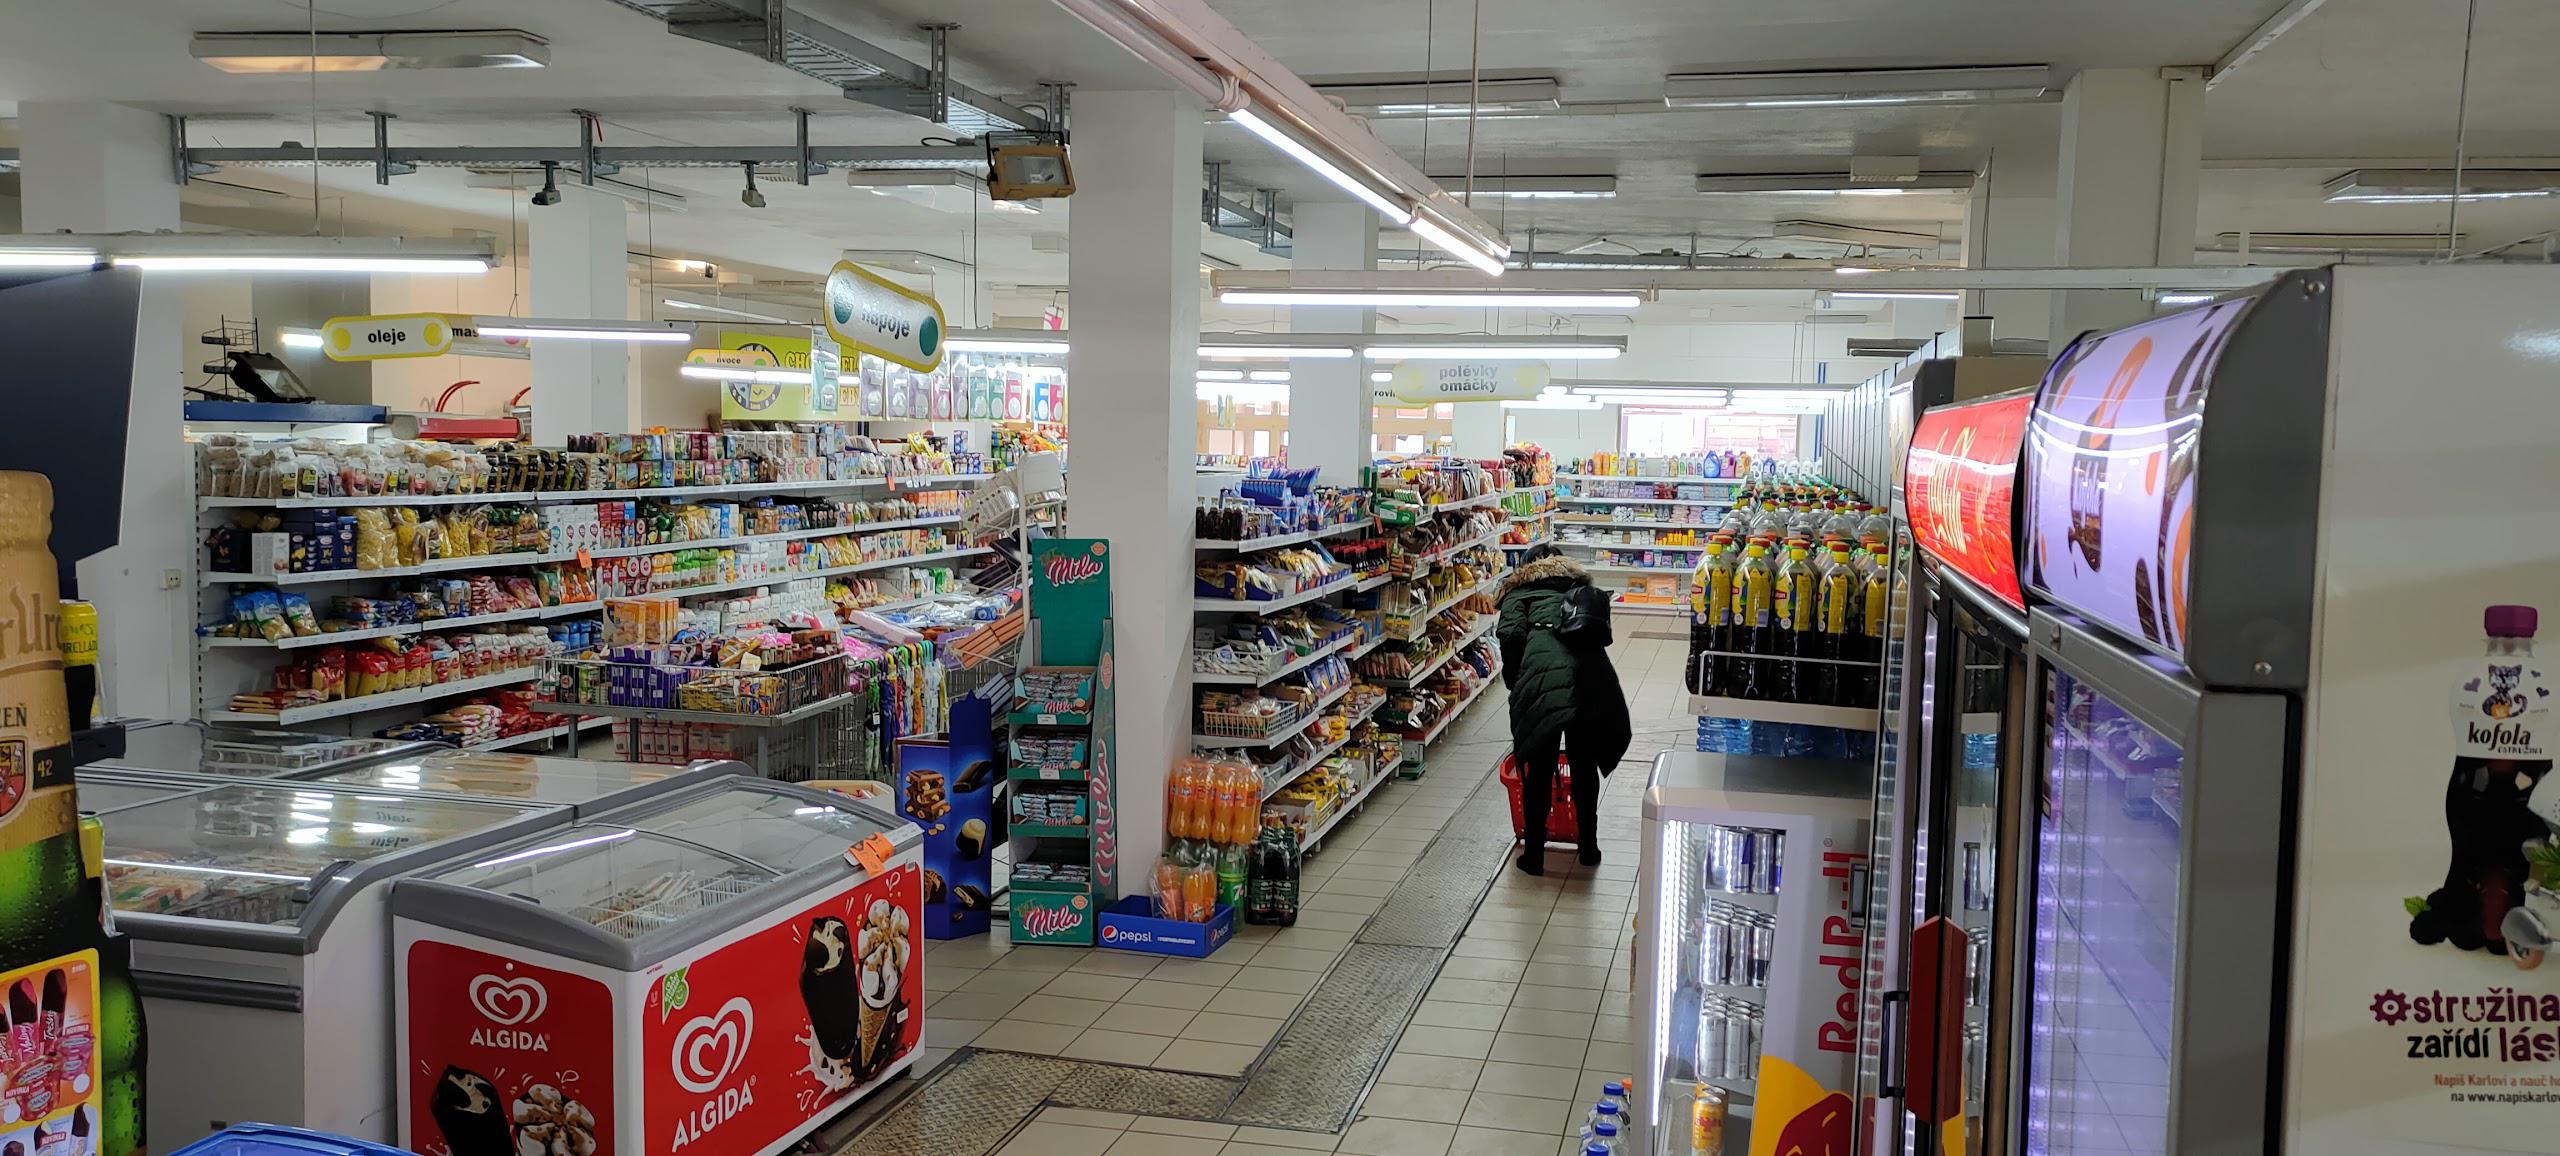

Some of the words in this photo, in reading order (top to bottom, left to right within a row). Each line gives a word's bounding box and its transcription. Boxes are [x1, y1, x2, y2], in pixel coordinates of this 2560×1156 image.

[367, 329, 406, 345] oleje
[1440, 365, 1498, 380] polévky
[1439, 378, 1498, 393] omáčky
[1045, 553, 1103, 587] Mila
[2468, 721, 2532, 751] kofola
[37, 759, 53, 777] 42
[1091, 739, 1116, 887] Mila
[1023, 905, 1082, 938] Mila
[1119, 929, 1152, 944] pepsi
[1818, 955, 1863, 1053] Red
[470, 1027, 548, 1052] ALGIDA
[2407, 1027, 2491, 1058] zařídí
[2499, 1026, 2560, 1062] lás
[2434, 1074, 2465, 1088] Napiš
[2468, 1074, 2508, 1087] Karlovi
[2510, 1078, 2517, 1087] a
[2520, 1074, 2547, 1087] nauč
[2451, 1093, 2464, 1102] na
[671, 1080, 754, 1153] ALGIDA
